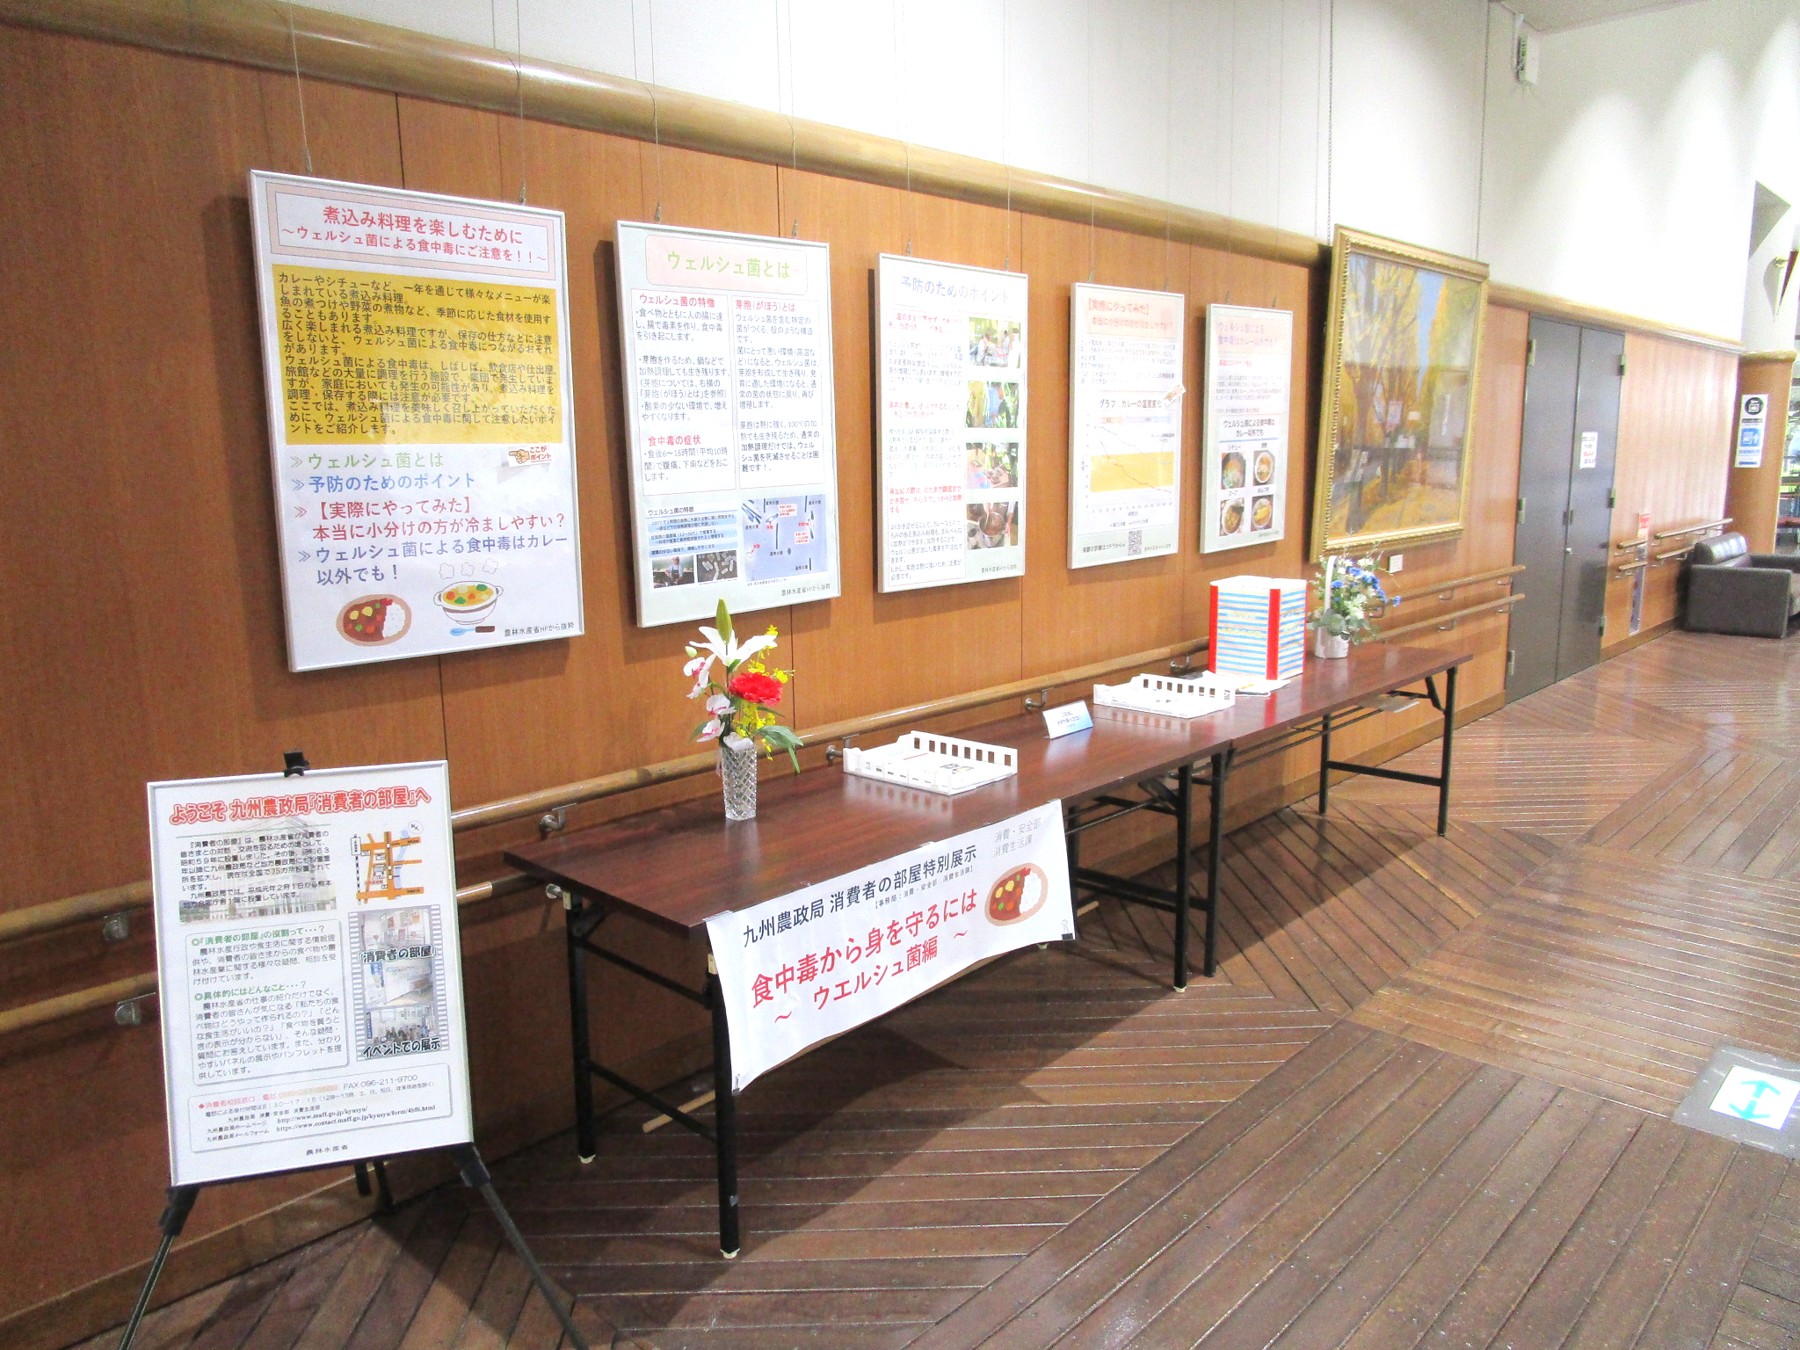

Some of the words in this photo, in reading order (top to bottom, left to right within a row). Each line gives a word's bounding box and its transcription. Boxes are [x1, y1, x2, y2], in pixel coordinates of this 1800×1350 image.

[323, 205, 523, 245] 煮込み料理を楽しむために
[667, 251, 791, 279] ウェルシュ菌とは
[901, 275, 1008, 304] 予防のためのポイント
[282, 308, 377, 325] ることもあります。
[284, 344, 347, 357] があります。
[648, 435, 702, 446] 食中毒の症状
[308, 452, 444, 470] ウェルシュ菌とは
[308, 472, 475, 494] 予防のためのポイント
[319, 496, 473, 520] 【実際にやってみた】
[312, 513, 566, 543] 本当に小分けの方が冷ましやすい？
[316, 534, 568, 561] ウェルシュ菌による食中毒はカレー
[316, 564, 400, 587] 以外でも！
[169, 800, 227, 825] ようこそ
[229, 786, 431, 822] 九州農政局『消費者の部屋』へ
[744, 899, 825, 948] 九州農政局
[829, 844, 977, 913] 消費者の部屋特別展示
[751, 889, 978, 1009] 食中毒から身を守るには
[362, 1037, 441, 1059] イベントでの展示
